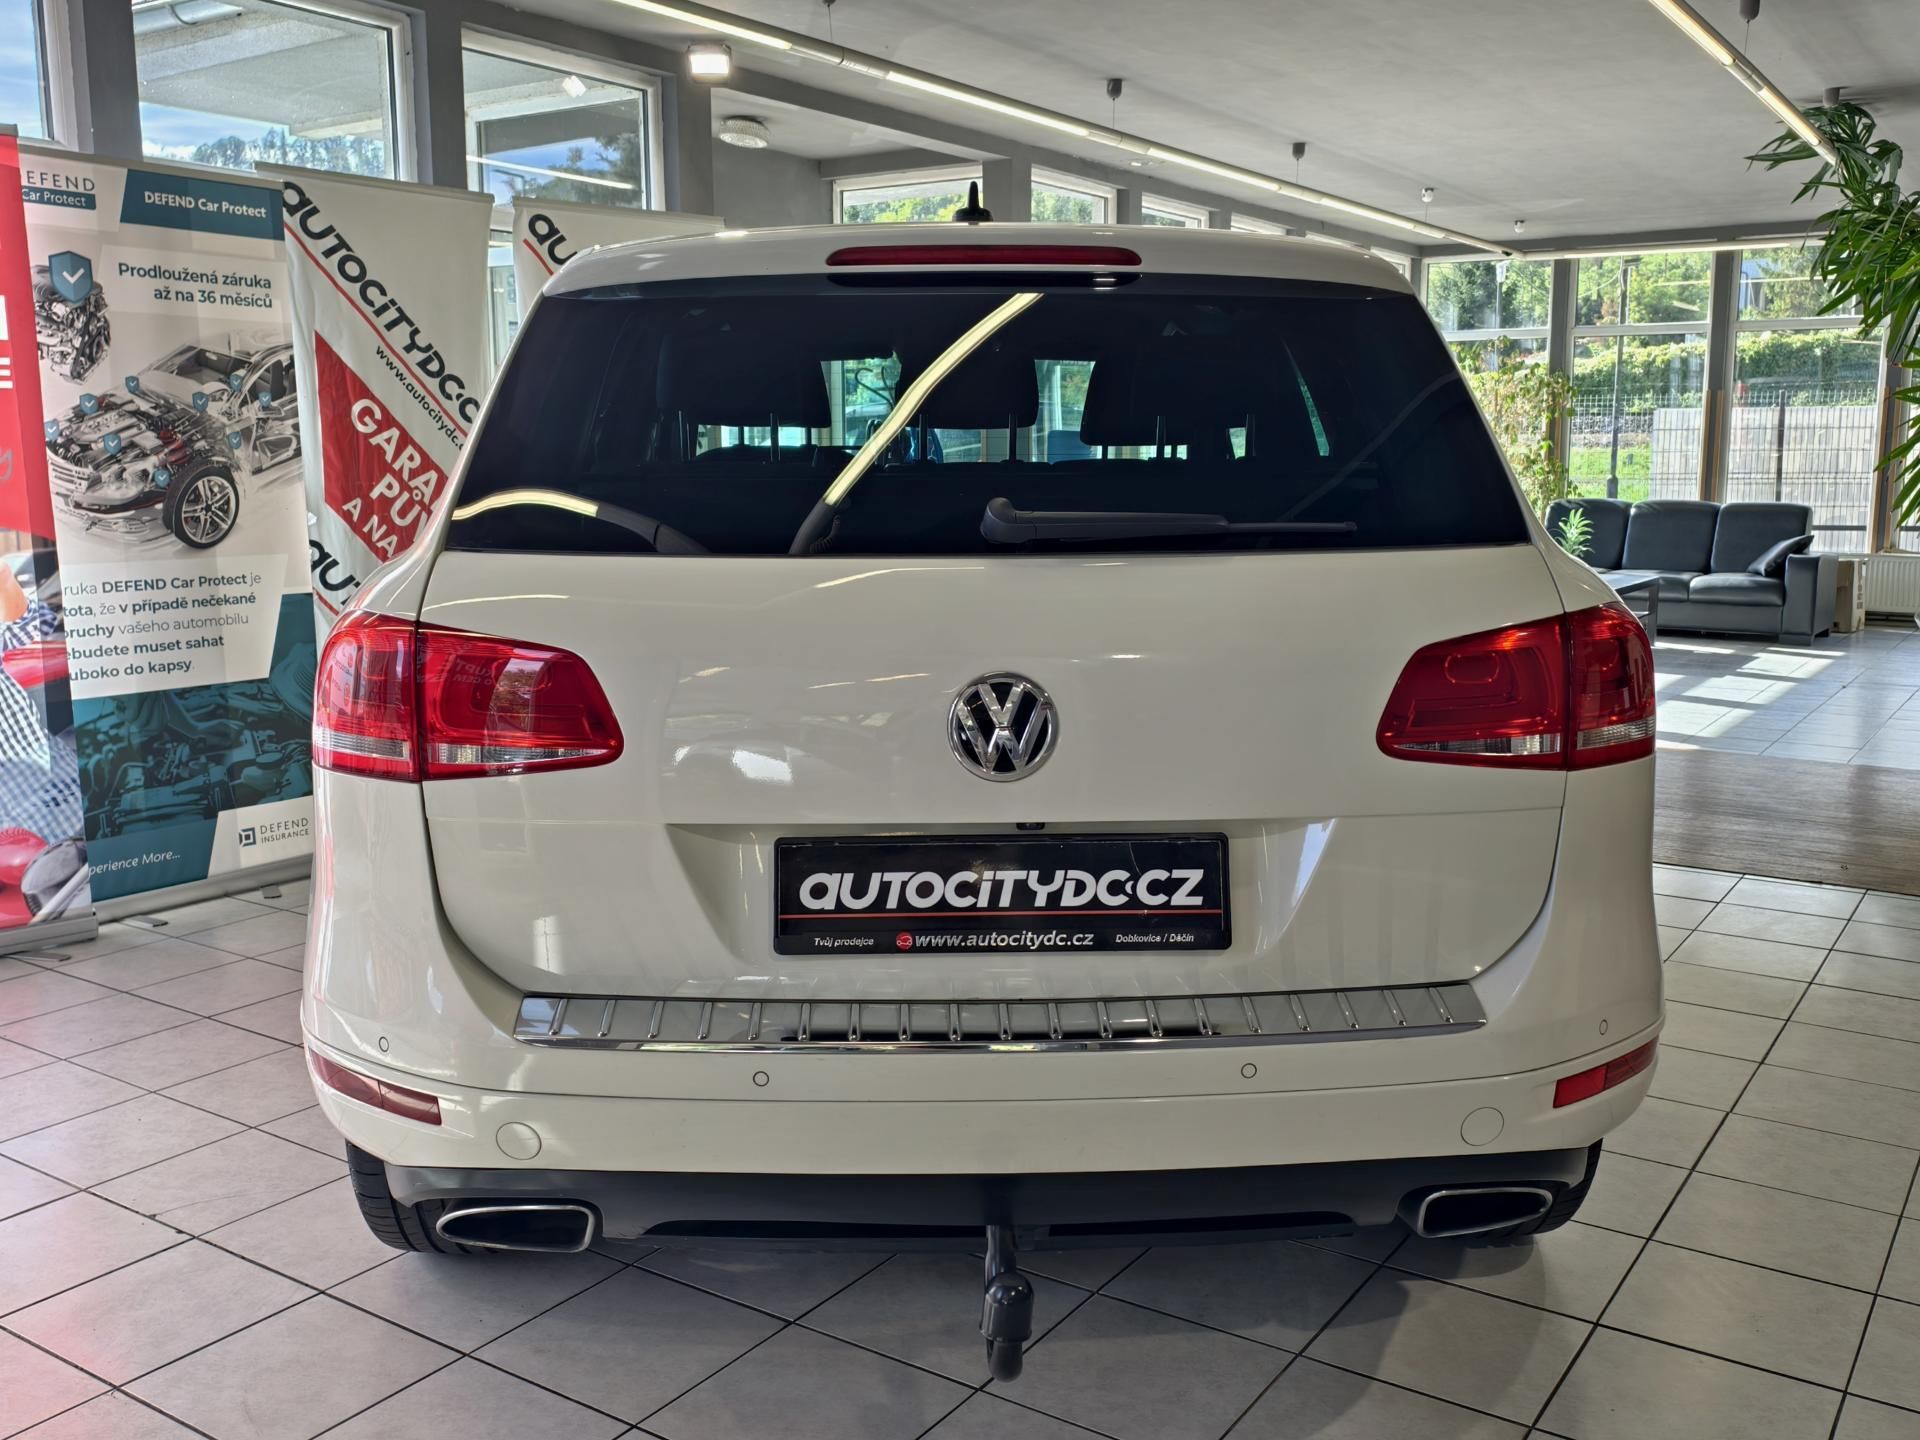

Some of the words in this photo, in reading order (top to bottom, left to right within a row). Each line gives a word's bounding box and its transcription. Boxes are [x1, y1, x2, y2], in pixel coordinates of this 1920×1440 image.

[22, 188, 41, 201] Car
[43, 190, 86, 207] Protect
[144, 191, 194, 209] DEFEND
[198, 197, 220, 212] Car
[222, 203, 267, 219] Protect
[118, 262, 218, 285] Prodloužená
[222, 268, 272, 289] záruka
[154, 284, 171, 301] až
[175, 291, 194, 303] na
[198, 289, 217, 304] 36
[220, 290, 273, 309] měsíců
[350, 399, 441, 512] GARA
[342, 497, 361, 522] A
[362, 514, 398, 558] NA
[64, 582, 98, 596] ruka
[102, 578, 167, 594] DEFEND
[170, 576, 195, 590] Car
[198, 573, 247, 588] Protect
[249, 571, 262, 588] je
[63, 605, 96, 617] tota,
[99, 602, 116, 616] že
[119, 604, 128, 614] v
[132, 595, 188, 616] případě
[192, 591, 256, 611] nečekané
[118, 619, 169, 635] vašeho
[173, 612, 249, 631] automobilu
[134, 638, 181, 654] muset
[185, 634, 225, 650] sahat
[124, 663, 144, 676] do
[260, 817, 309, 835] DEFEND
[261, 829, 309, 844] INSURANCE
[88, 857, 138, 877] perience
[142, 850, 180, 865] More...
[814, 936, 833, 948] Tvůj
[835, 936, 874, 948] prodejce
[915, 929, 1094, 950] www.autocitydc.cz
[1115, 933, 1161, 944] Dobkovice
[1169, 932, 1195, 944] Děčín
